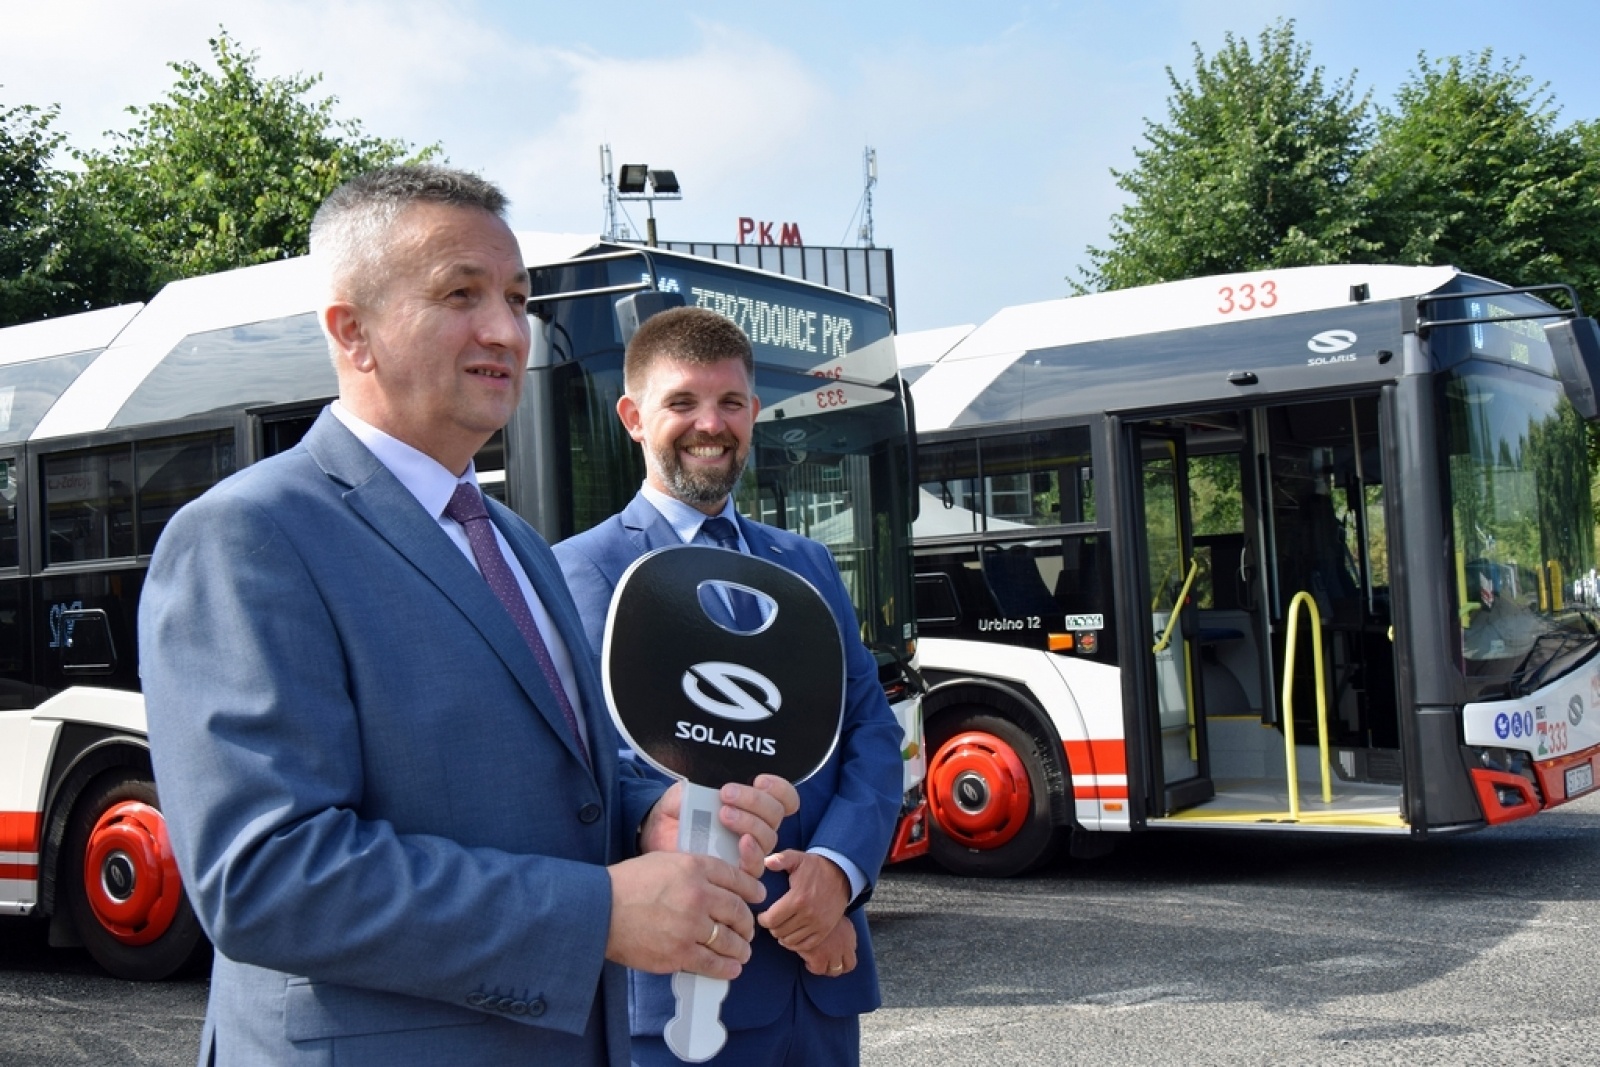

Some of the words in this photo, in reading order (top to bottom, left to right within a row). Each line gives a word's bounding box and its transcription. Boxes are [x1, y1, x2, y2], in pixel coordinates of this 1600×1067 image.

[738, 217, 802, 246] PKM
[1218, 280, 1277, 314] 333
[822, 314, 852, 358] PKP
[1307, 352, 1357, 366] SOLARIS
[978, 617, 1024, 631] Urbino
[1026, 616, 1041, 629] 12
[675, 721, 776, 756] SOLARIS
[1549, 721, 1568, 753] 333
